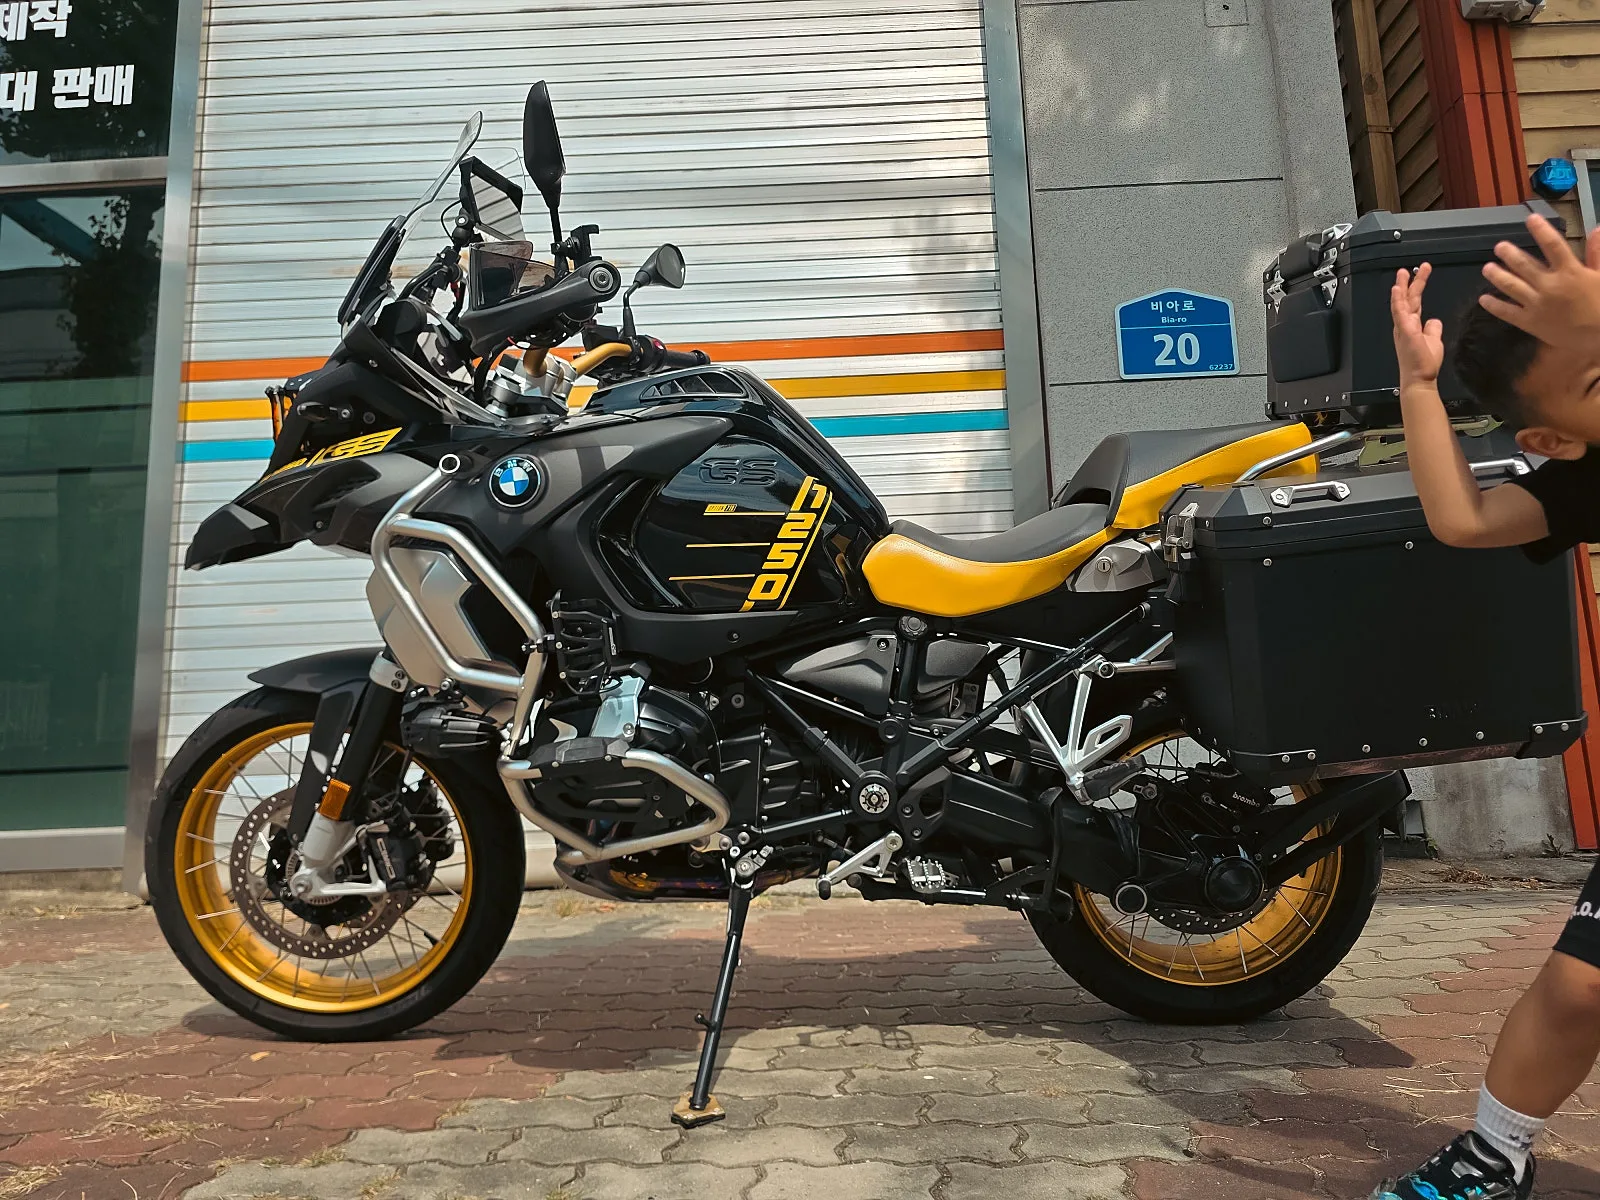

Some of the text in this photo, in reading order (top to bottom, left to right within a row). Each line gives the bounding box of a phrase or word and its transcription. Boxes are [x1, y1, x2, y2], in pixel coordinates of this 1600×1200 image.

[52, 64, 135, 109] 판매
[1150, 300, 1196, 313] 비아로
[1153, 332, 1200, 367] 20
[1208, 363, 1234, 371] 62237
[493, 459, 533, 477] BMW
[699, 457, 778, 486] GS
[1232, 791, 1261, 808] brembo
